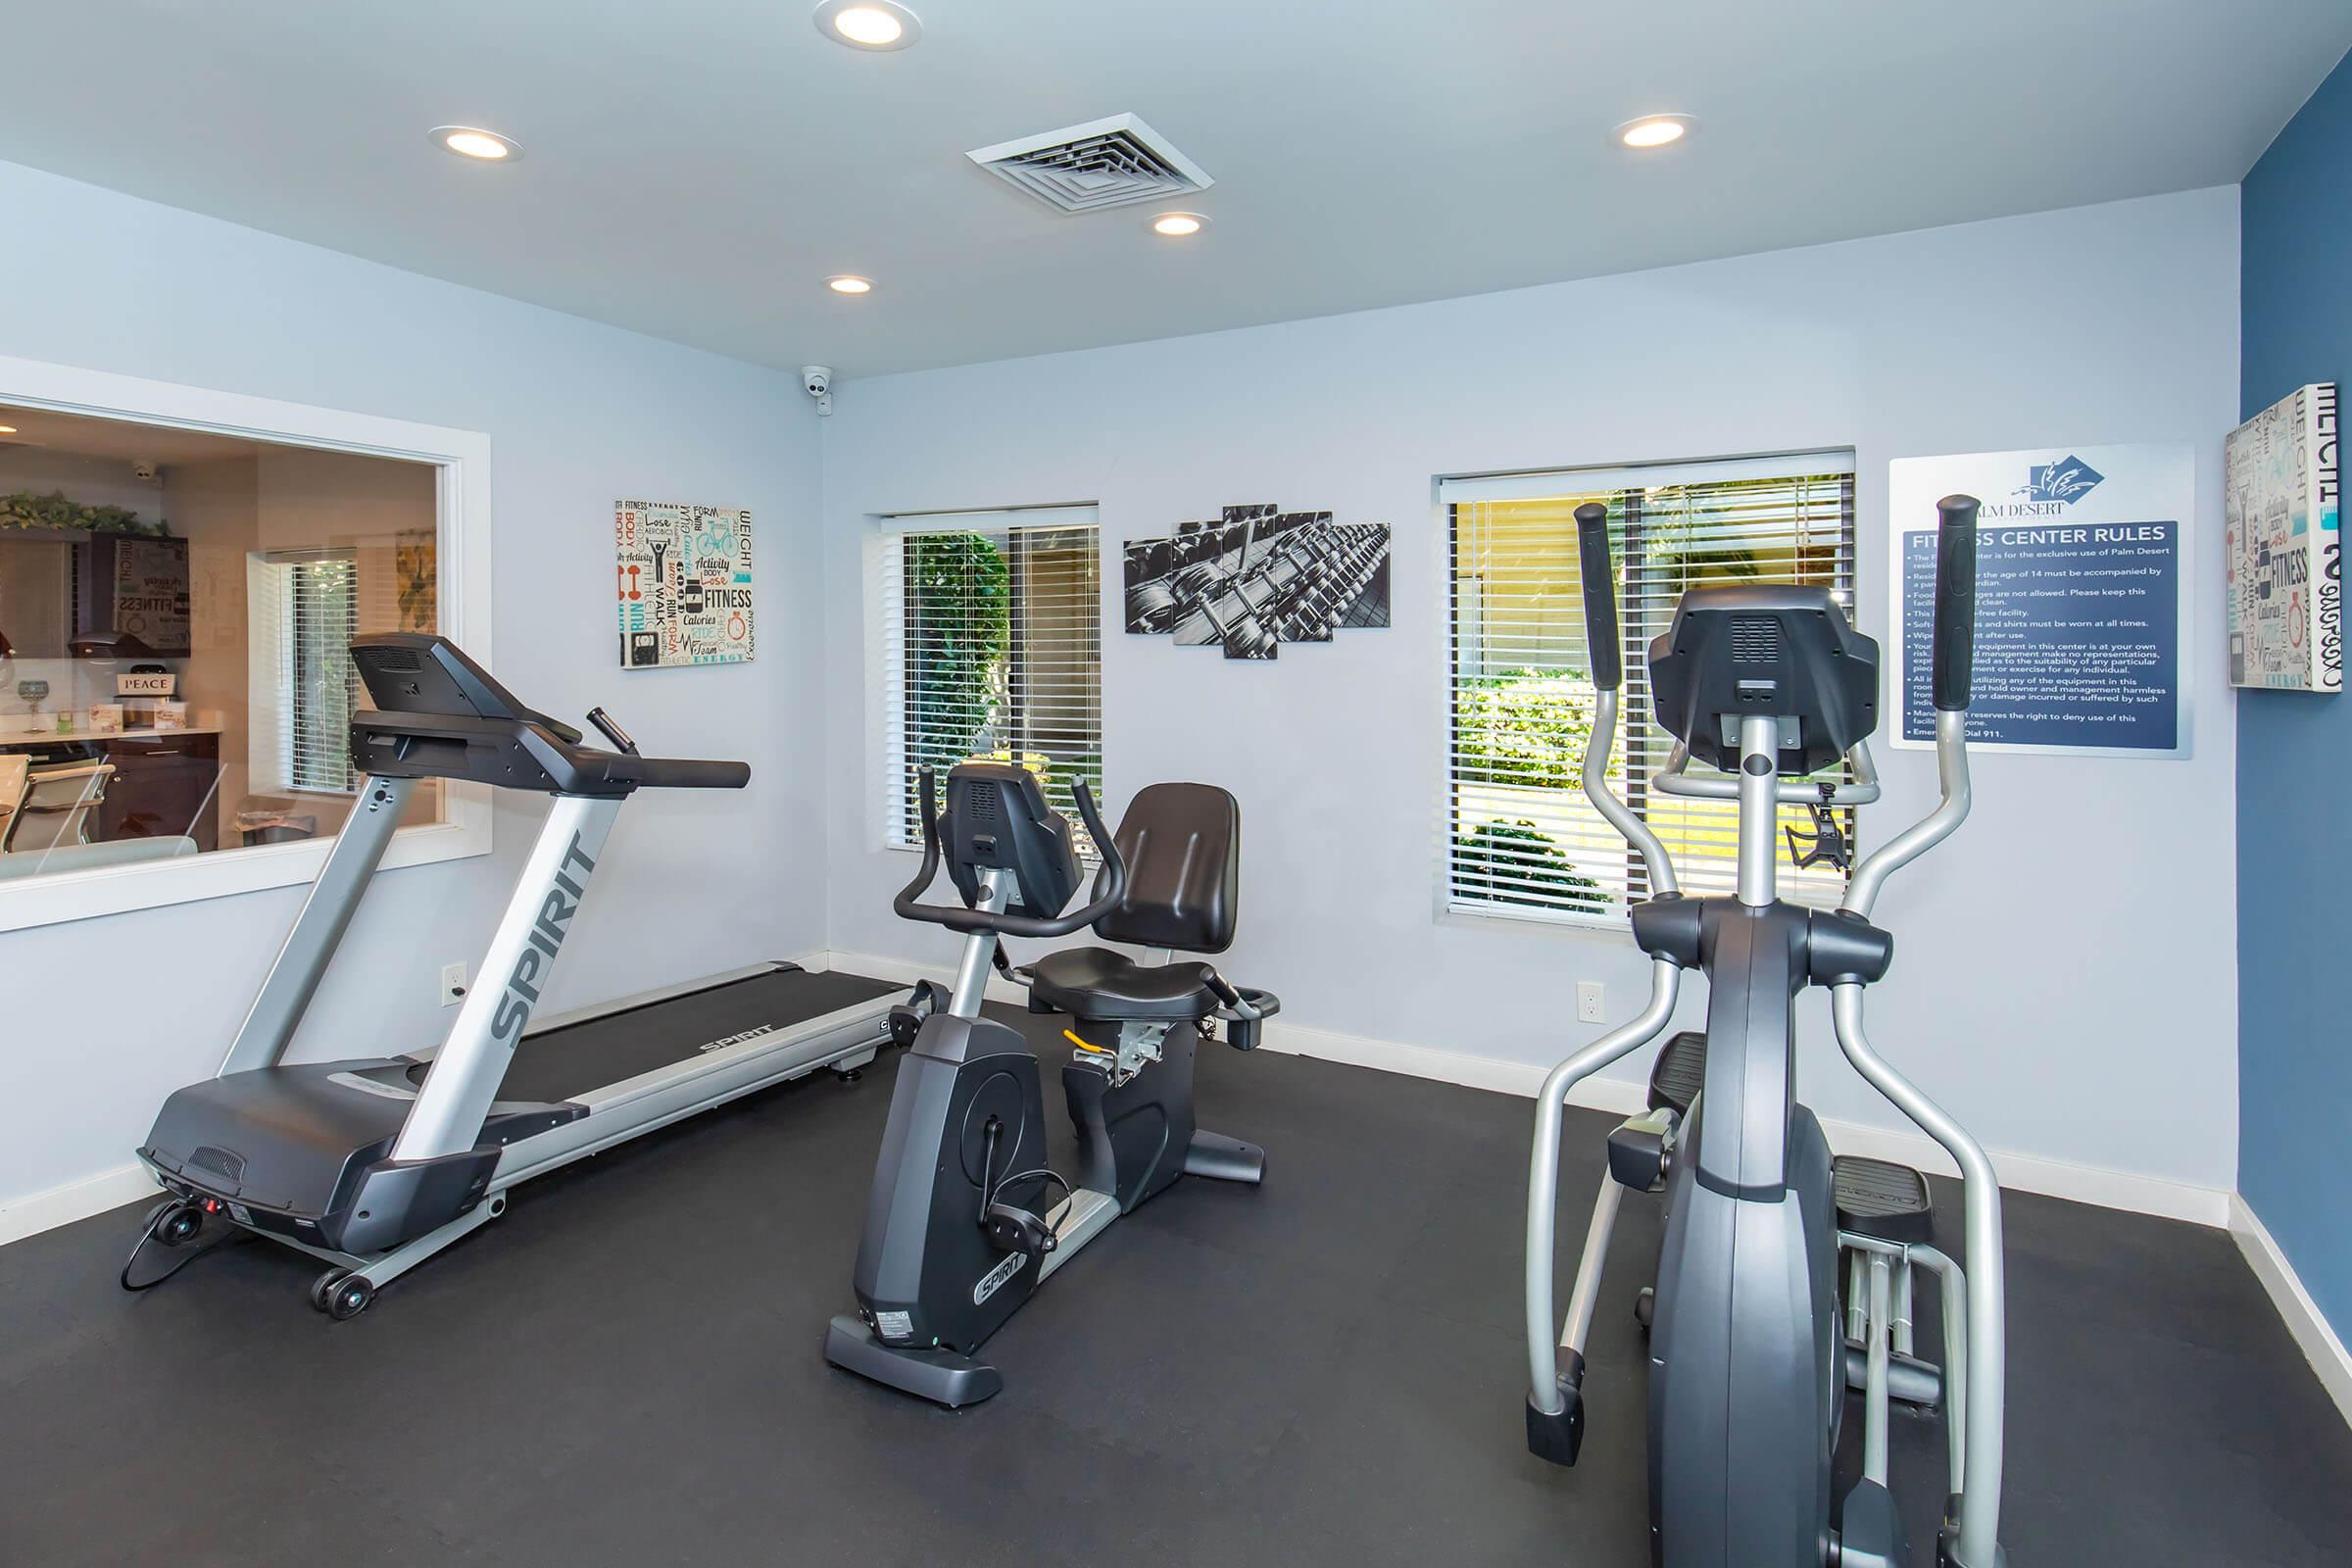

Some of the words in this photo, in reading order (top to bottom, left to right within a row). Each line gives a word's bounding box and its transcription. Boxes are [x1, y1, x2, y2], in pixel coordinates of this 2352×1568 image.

[2296, 390, 2306, 503] WEIGHT
[624, 500, 648, 510] FITNESS
[2008, 501, 2064, 516] DESERT
[693, 506, 719, 518] FORM
[645, 513, 671, 527] Lose
[694, 515, 703, 531] RUN
[625, 512, 635, 548] BODY
[1913, 532, 1994, 548] FITSS
[2000, 528, 2087, 546] CENTER
[2094, 525, 2166, 543] RULES
[739, 511, 752, 570] WEIGHT
[1994, 551, 2002, 560] is
[2036, 549, 2078, 558] exclusive
[2098, 548, 2110, 557] of
[2111, 547, 2134, 557] Palm
[2136, 547, 2170, 556] Desert
[695, 556, 730, 573] Activity
[2272, 546, 2308, 589] FITNESS
[2069, 568, 2082, 577] be
[2083, 567, 2147, 577] accompanied
[2149, 566, 2162, 576] by
[700, 571, 729, 586] Lose
[2030, 588, 2068, 597] allowed.
[2070, 588, 2100, 597] Please
[2102, 588, 2127, 598] keep
[2128, 587, 2146, 596] this
[705, 589, 753, 610] FITNESS
[655, 587, 666, 626] WALK
[666, 599, 677, 618] RUN
[629, 603, 645, 631] RUN
[683, 614, 716, 626] Calories
[1999, 610, 2030, 618] facility.
[1984, 619, 2002, 628] and
[2003, 619, 2028, 628] shirts
[2030, 619, 2052, 628] must
[2119, 619, 2149, 628] times.
[667, 619, 679, 657] FORM
[1978, 643, 2026, 652] equipment
[2088, 642, 2097, 651] is
[2111, 643, 2132, 652] your
[1982, 650, 2039, 660] management
[2082, 651, 2161, 660] representations,
[2034, 658, 2078, 666] suitability
[2111, 658, 2157, 667] particular
[2064, 666, 2081, 675] any
[2082, 665, 2131, 674] individual.
[124, 678, 169, 690] PEACE
[1973, 675, 2007, 686] utilizing
[2008, 677, 2025, 686] any
[2038, 676, 2054, 685] the
[2055, 677, 2106, 687] equipment
[2108, 677, 2118, 686] in
[2119, 677, 2137, 686] this
[2059, 686, 2121, 695] management
[2123, 686, 2167, 695] harmless
[1989, 692, 2027, 702] damage
[2028, 693, 2066, 702] incurred
[2080, 694, 2120, 703] suffered
[2121, 694, 2133, 705] by
[2135, 695, 2159, 704] such
[1970, 711, 2008, 720] reserves
[2009, 711, 2025, 720] the
[2026, 712, 2048, 722] right
[2062, 712, 2085, 723] deny
[2106, 713, 2117, 722] of
[2119, 714, 2136, 723] this
[1983, 729, 2004, 738] 911.
[490, 828, 596, 1050] SPIRIT
[699, 1023, 774, 1054] SPIRIT
[981, 1253, 1022, 1298] SPIRIT
